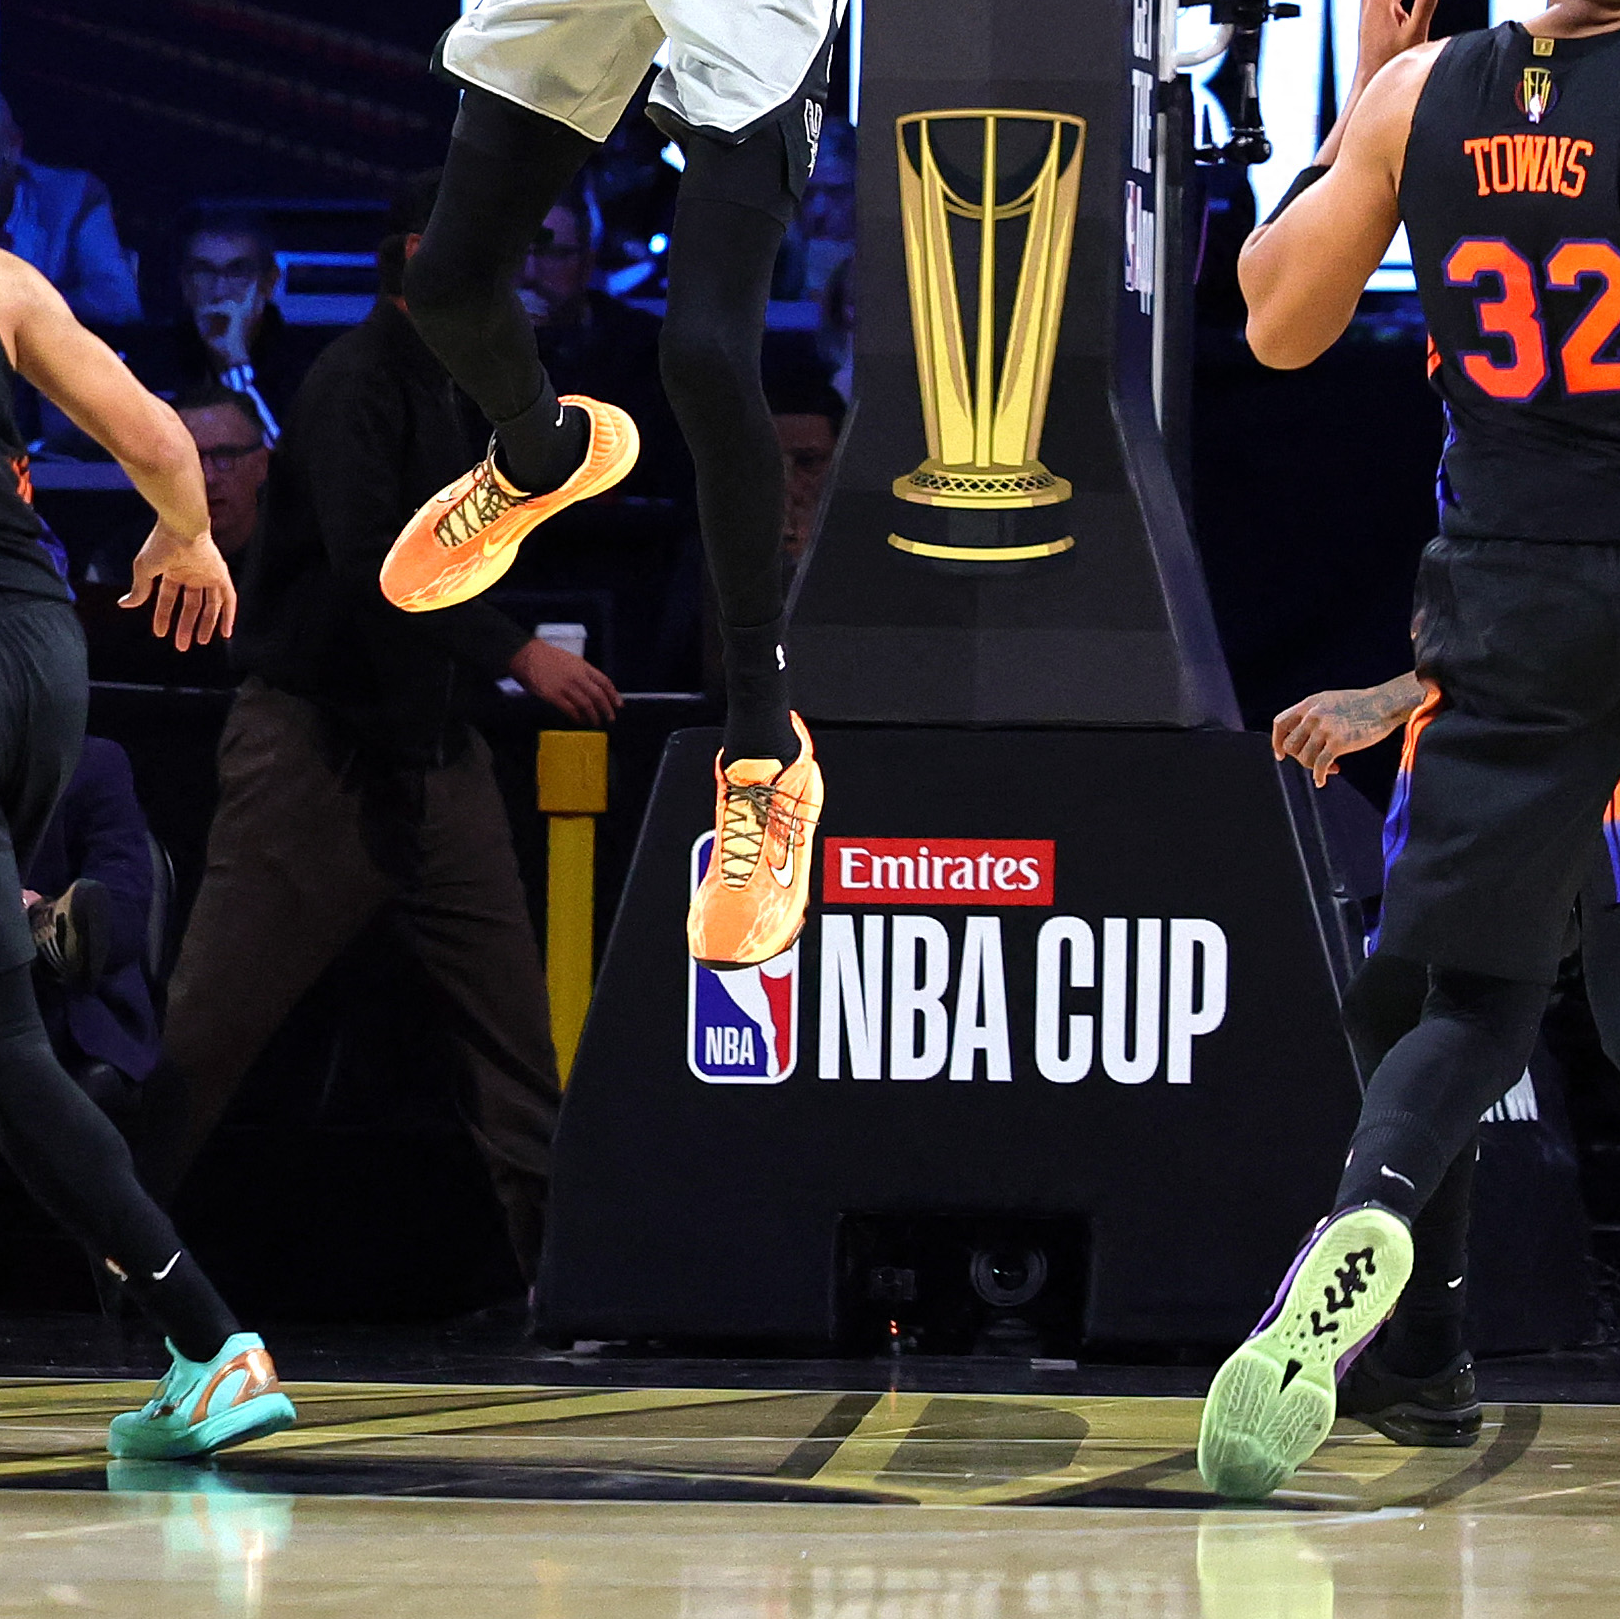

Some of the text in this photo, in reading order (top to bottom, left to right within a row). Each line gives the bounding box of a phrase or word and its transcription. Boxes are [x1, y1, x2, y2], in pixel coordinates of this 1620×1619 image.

[1464, 135, 1594, 197] TOWNS
[839, 847, 1040, 891] Emirates
[818, 914, 1229, 1085] NBA CUP
[705, 1026, 756, 1066] NBA
